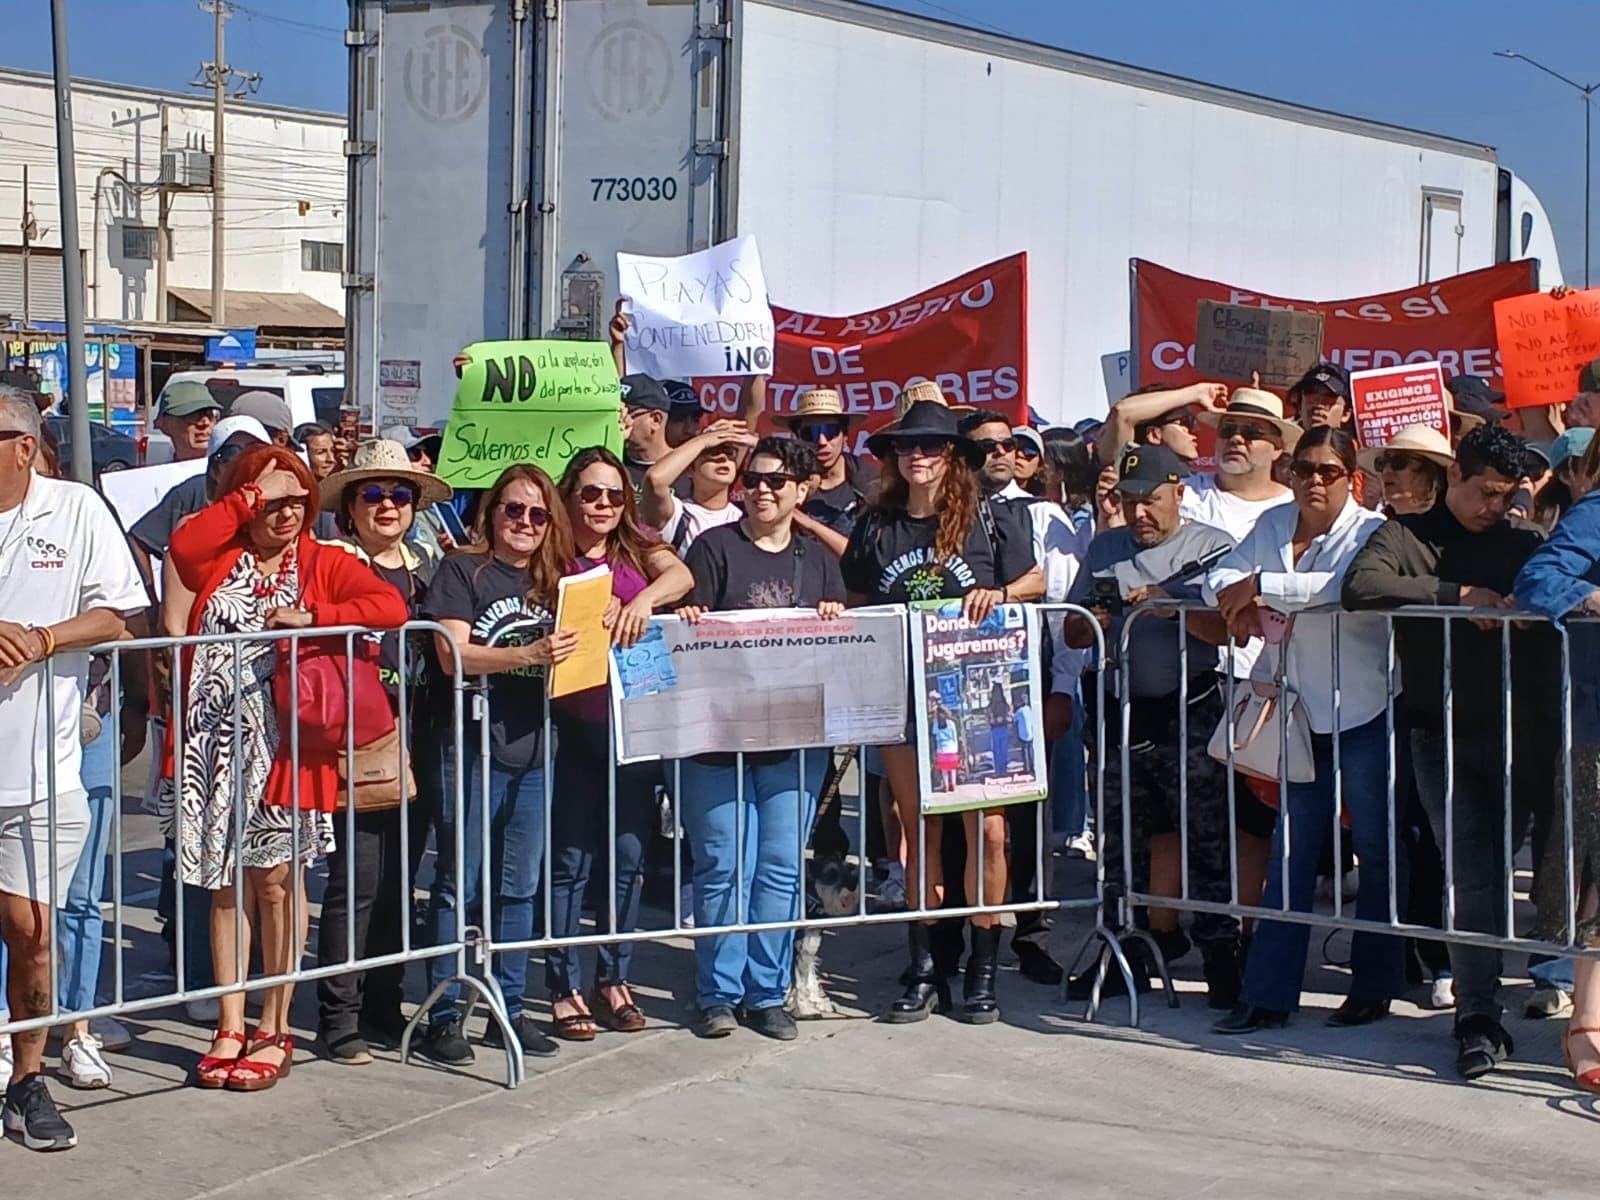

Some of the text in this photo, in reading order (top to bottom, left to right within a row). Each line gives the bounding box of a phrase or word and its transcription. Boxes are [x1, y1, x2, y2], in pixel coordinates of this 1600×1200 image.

[590, 177, 677, 202] 773030
[625, 258, 752, 304] PLAYAS
[1401, 285, 1450, 320] SÍ
[777, 313, 826, 336] AL
[1508, 312, 1537, 329] NO
[1543, 308, 1561, 322] AL
[1515, 337, 1542, 352] NO
[810, 344, 865, 376] DE
[482, 355, 537, 403] NO
[1365, 383, 1432, 403] EXIGIMOS
[1363, 410, 1442, 429] AMPLIACIÓN
[447, 422, 531, 463] Salvemos
[535, 426, 556, 458] el
[1364, 427, 1388, 438] DEL
[1125, 455, 1139, 475] P
[672, 634, 876, 653] AMPLIACIÓN MODERNA
[925, 630, 1026, 663] jugaremos?
